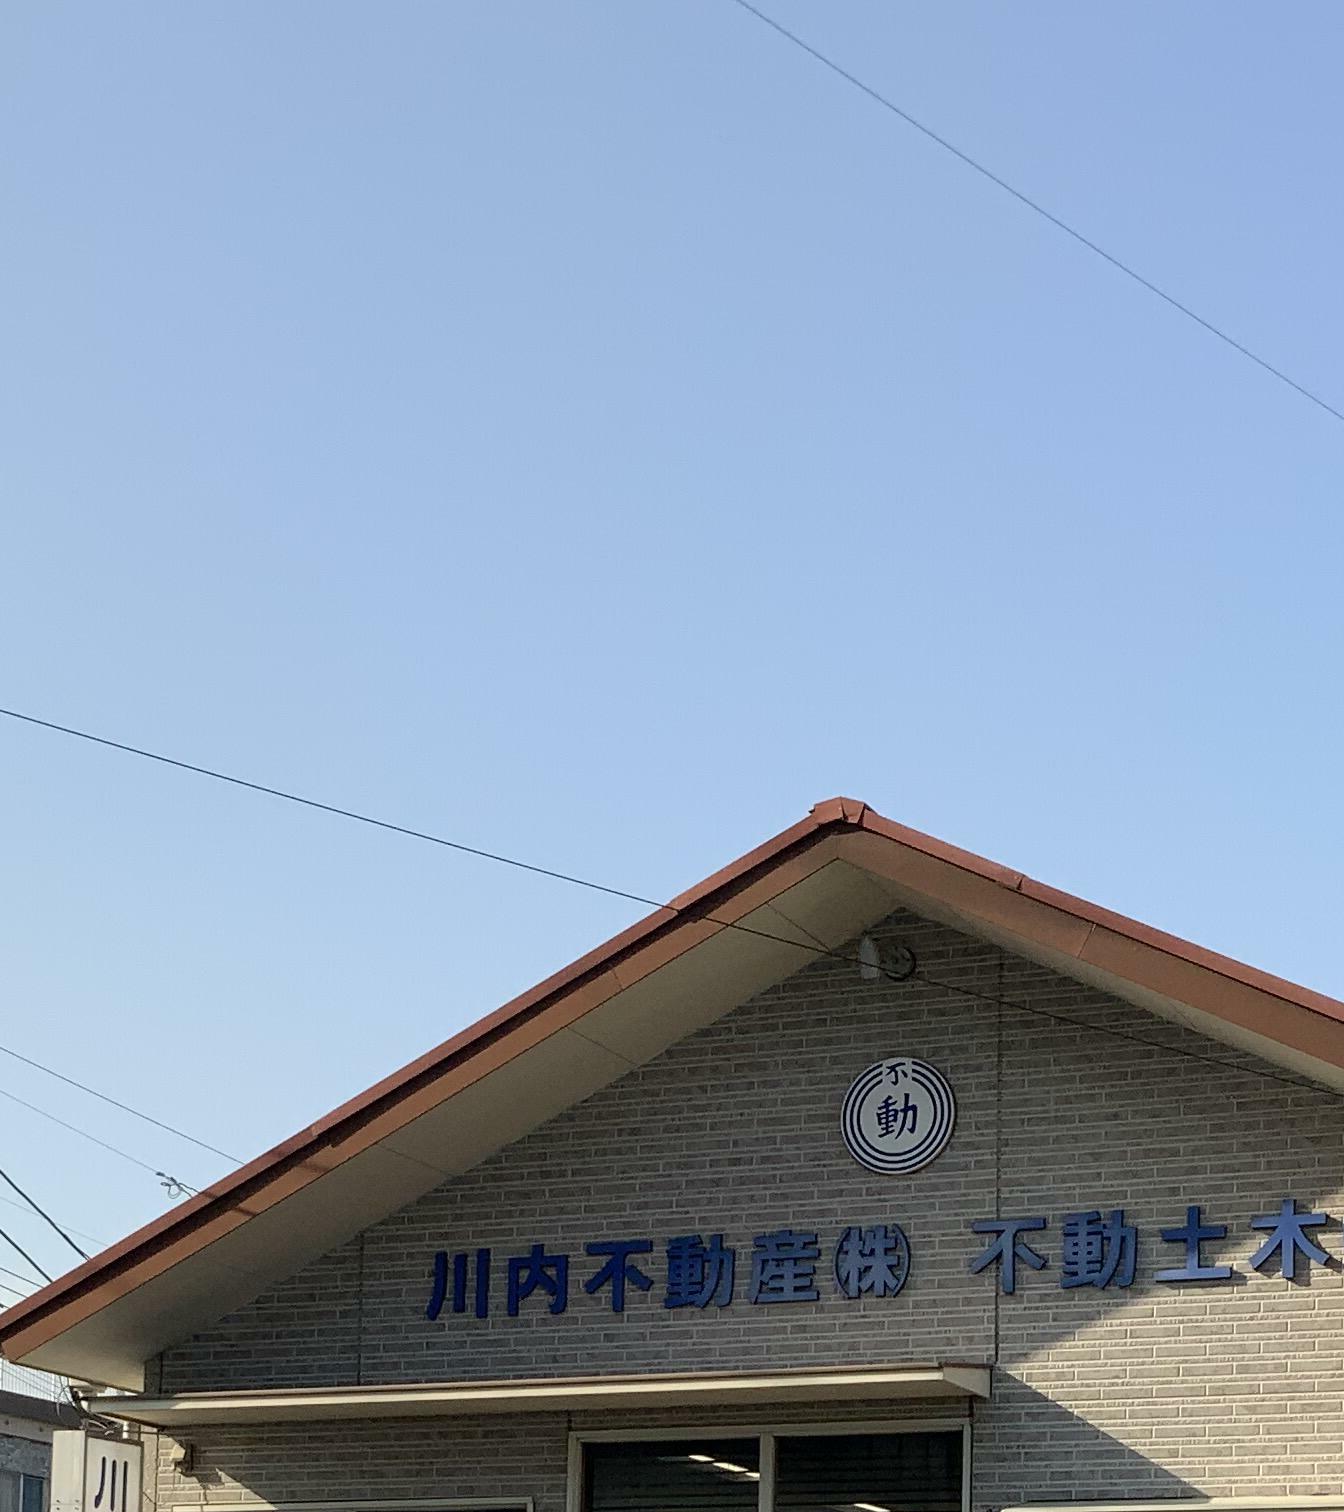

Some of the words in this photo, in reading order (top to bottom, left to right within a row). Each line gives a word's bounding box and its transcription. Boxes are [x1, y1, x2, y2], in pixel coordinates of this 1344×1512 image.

[425, 1222, 912, 1322] 川内不動産(株)
